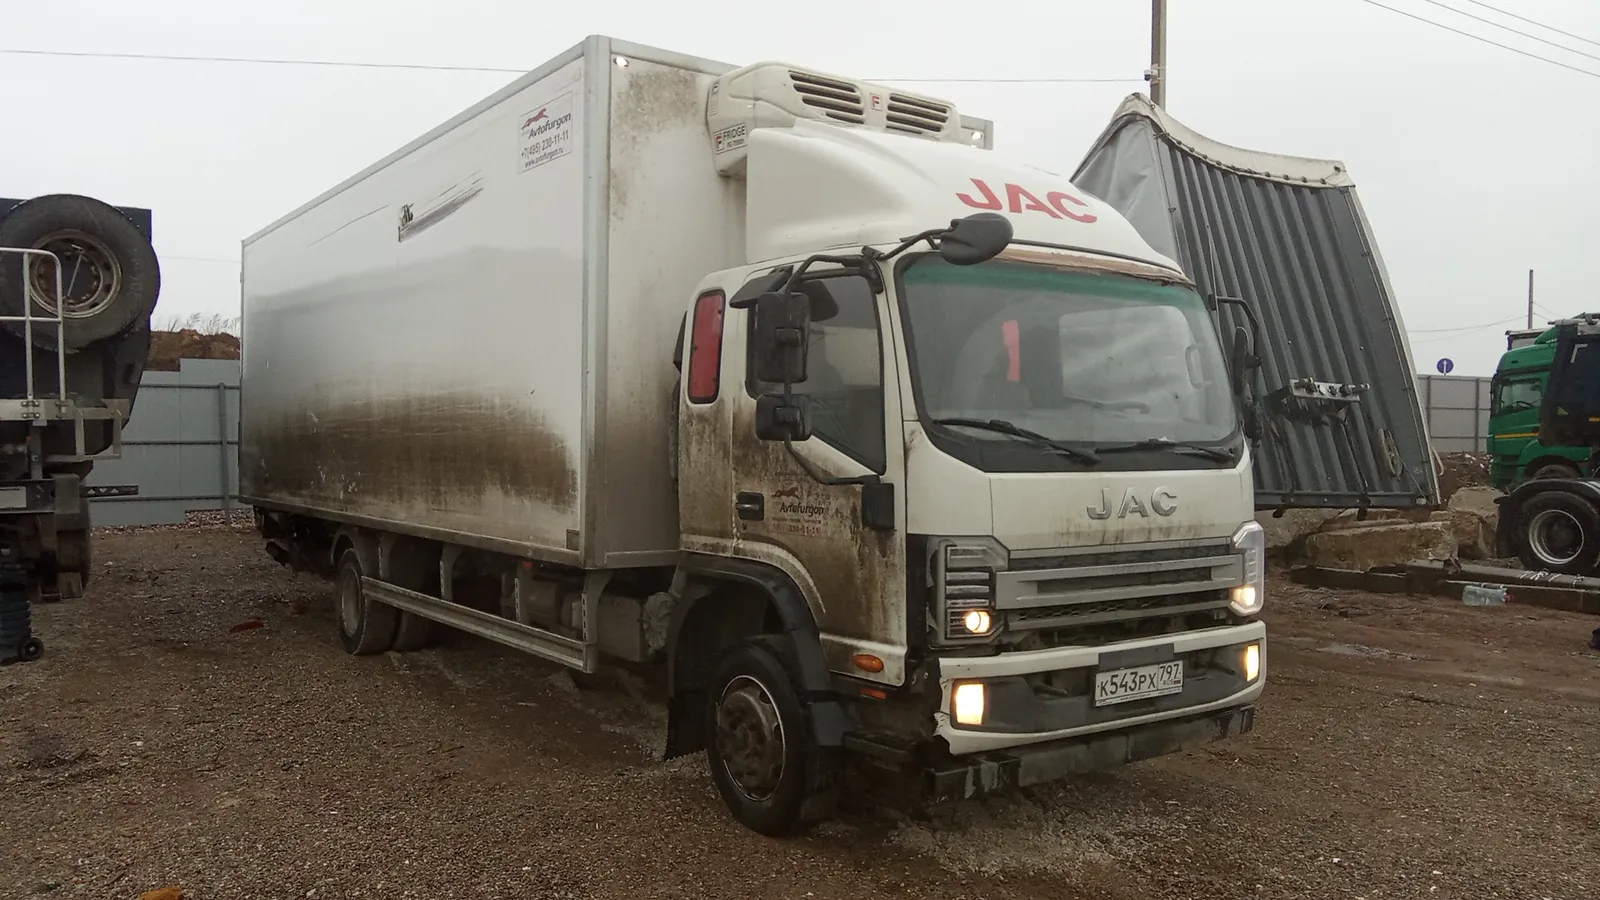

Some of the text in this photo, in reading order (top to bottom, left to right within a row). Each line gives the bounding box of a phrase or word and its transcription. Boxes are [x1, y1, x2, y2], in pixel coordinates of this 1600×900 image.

[871, 95, 880, 107] F
[528, 113, 571, 139] Avtofurgon
[723, 125, 746, 141] FRIDGE
[541, 129, 569, 151] 230-11-11
[955, 178, 1098, 223] JAC
[779, 502, 825, 517] Avtofurgon
[1086, 486, 1178, 520] JAC
[1159, 663, 1180, 682] 797
